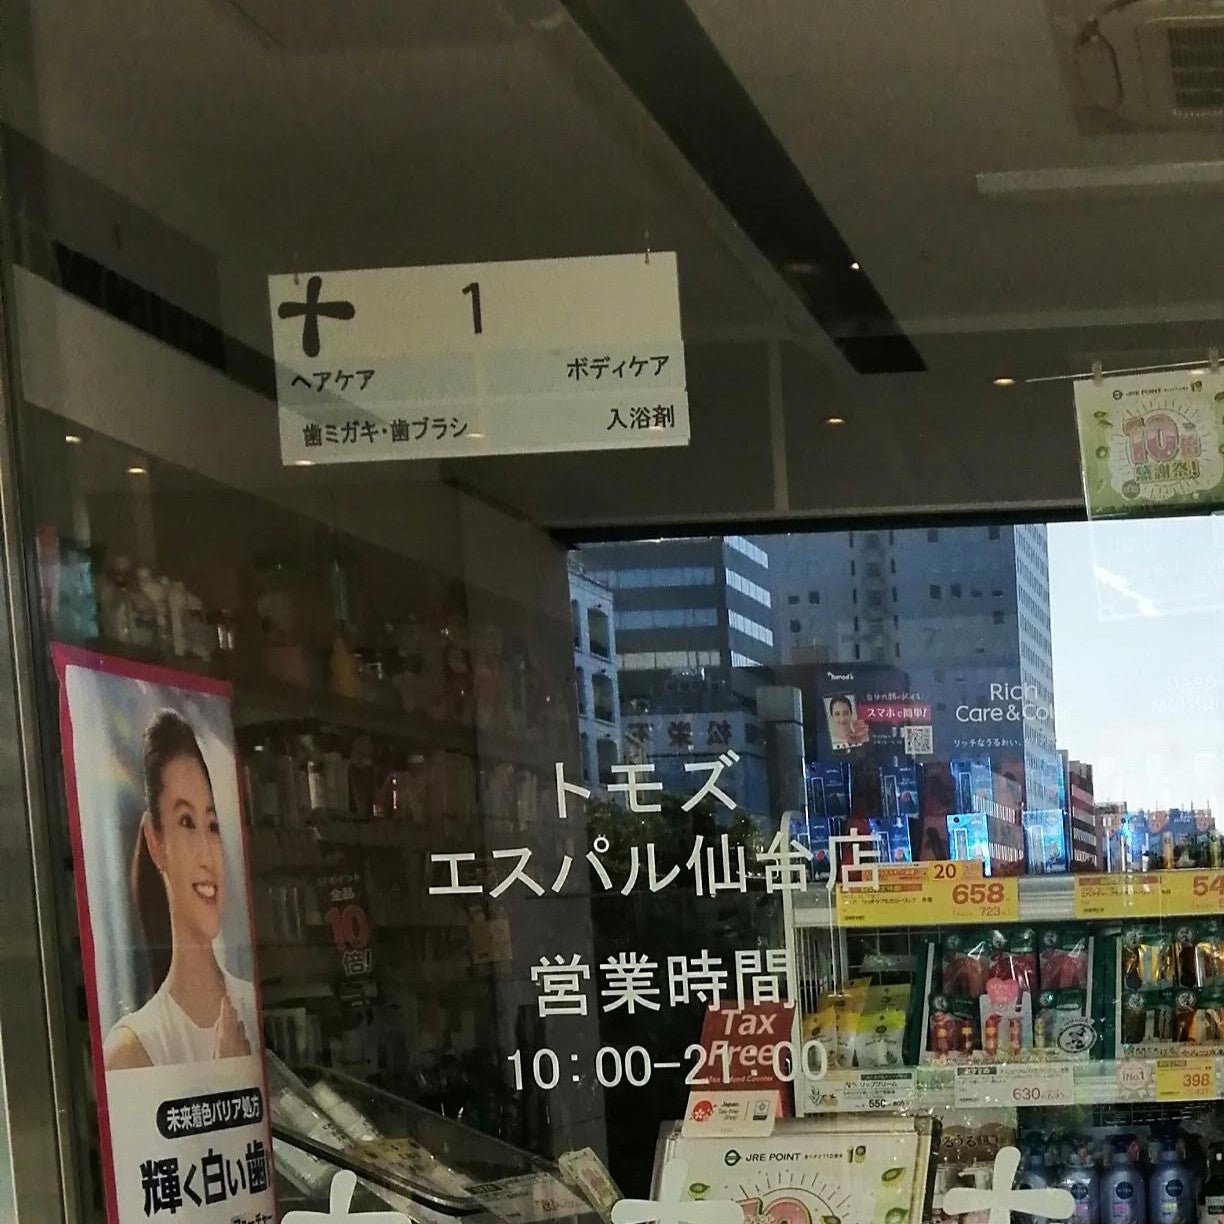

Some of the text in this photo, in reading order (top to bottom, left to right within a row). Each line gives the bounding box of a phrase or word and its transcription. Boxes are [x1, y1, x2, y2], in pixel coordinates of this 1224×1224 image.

[462, 281, 483, 335] 1
[291, 368, 376, 393] ヘアケア
[566, 354, 670, 382] ボディケア
[606, 404, 676, 431] 入浴剤
[302, 416, 469, 447] 歯ミガキ・歯ブラシ
[989, 682, 1038, 702] Rich
[554, 748, 742, 820] トモズ
[528, 827, 882, 899] エスパル仙台店
[934, 864, 957, 879] 20
[952, 882, 1005, 905] 658
[530, 948, 797, 1018] 営業時間
[721, 1009, 777, 1036] Tax
[1183, 1073, 1210, 1087] 398
[1012, 1087, 1041, 1101] 630
[166, 1094, 261, 1132] 未来着色バリア処方
[746, 1153, 767, 1162] JRE
[768, 1152, 802, 1162] POINT
[139, 1138, 270, 1217] 輝く白い歯
